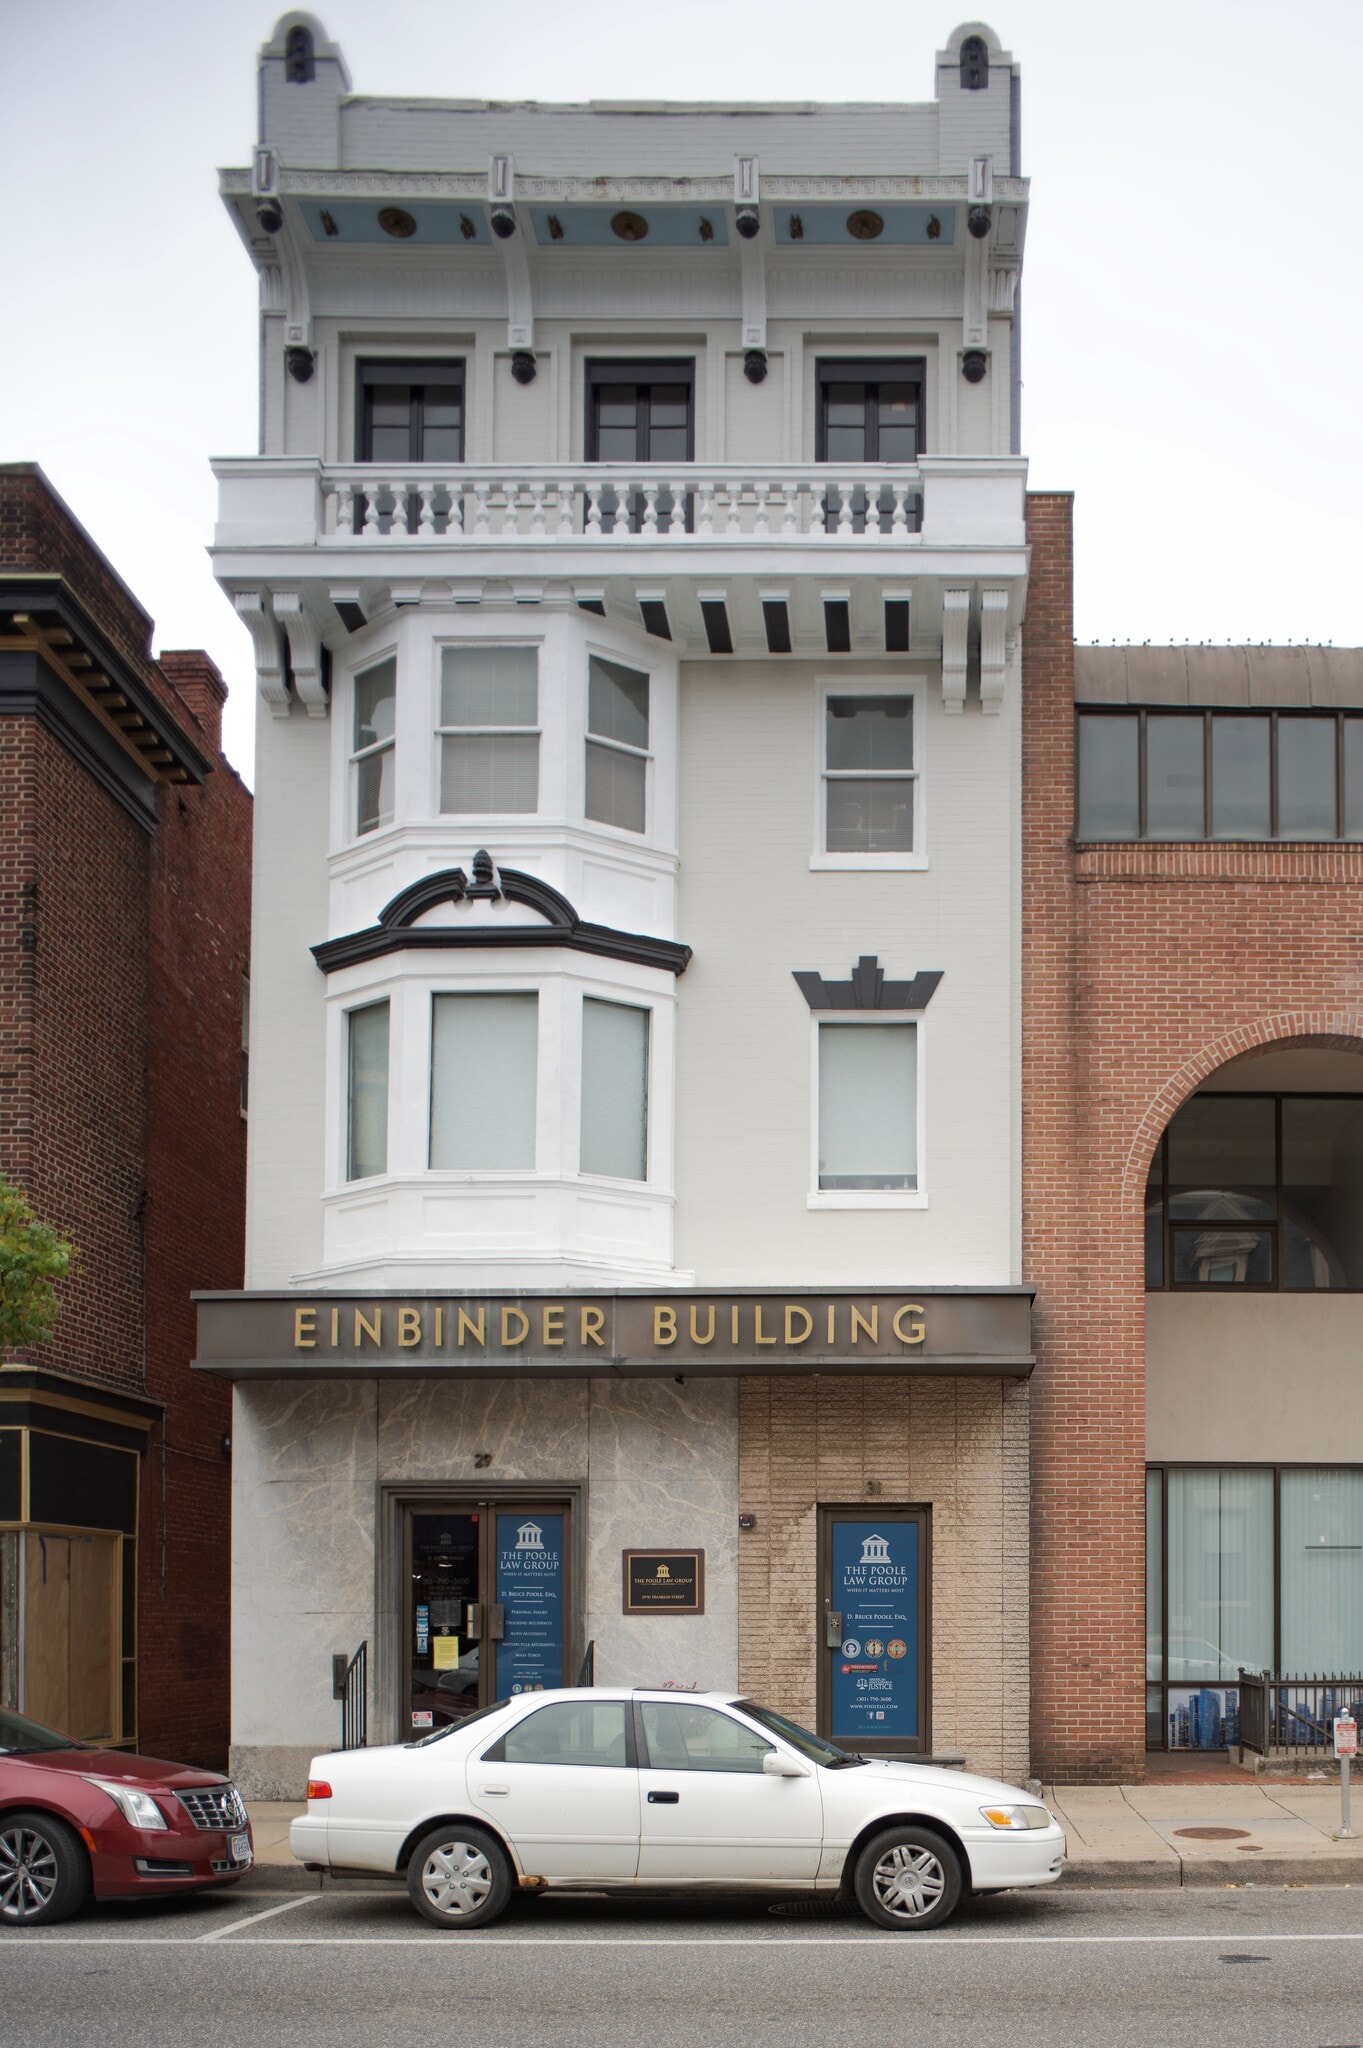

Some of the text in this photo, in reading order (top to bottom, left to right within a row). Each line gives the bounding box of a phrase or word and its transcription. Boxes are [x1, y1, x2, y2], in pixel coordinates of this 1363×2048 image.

[294, 1304, 926, 1348] EINBINDER BUILDING
[502, 1551, 558, 1560] THE POOLE
[500, 1561, 560, 1570] LAW GROUP
[845, 1566, 906, 1575] THE POOLE
[844, 1576, 908, 1585] LAW GROUP
[868, 1683, 893, 1691] JUSTICE
